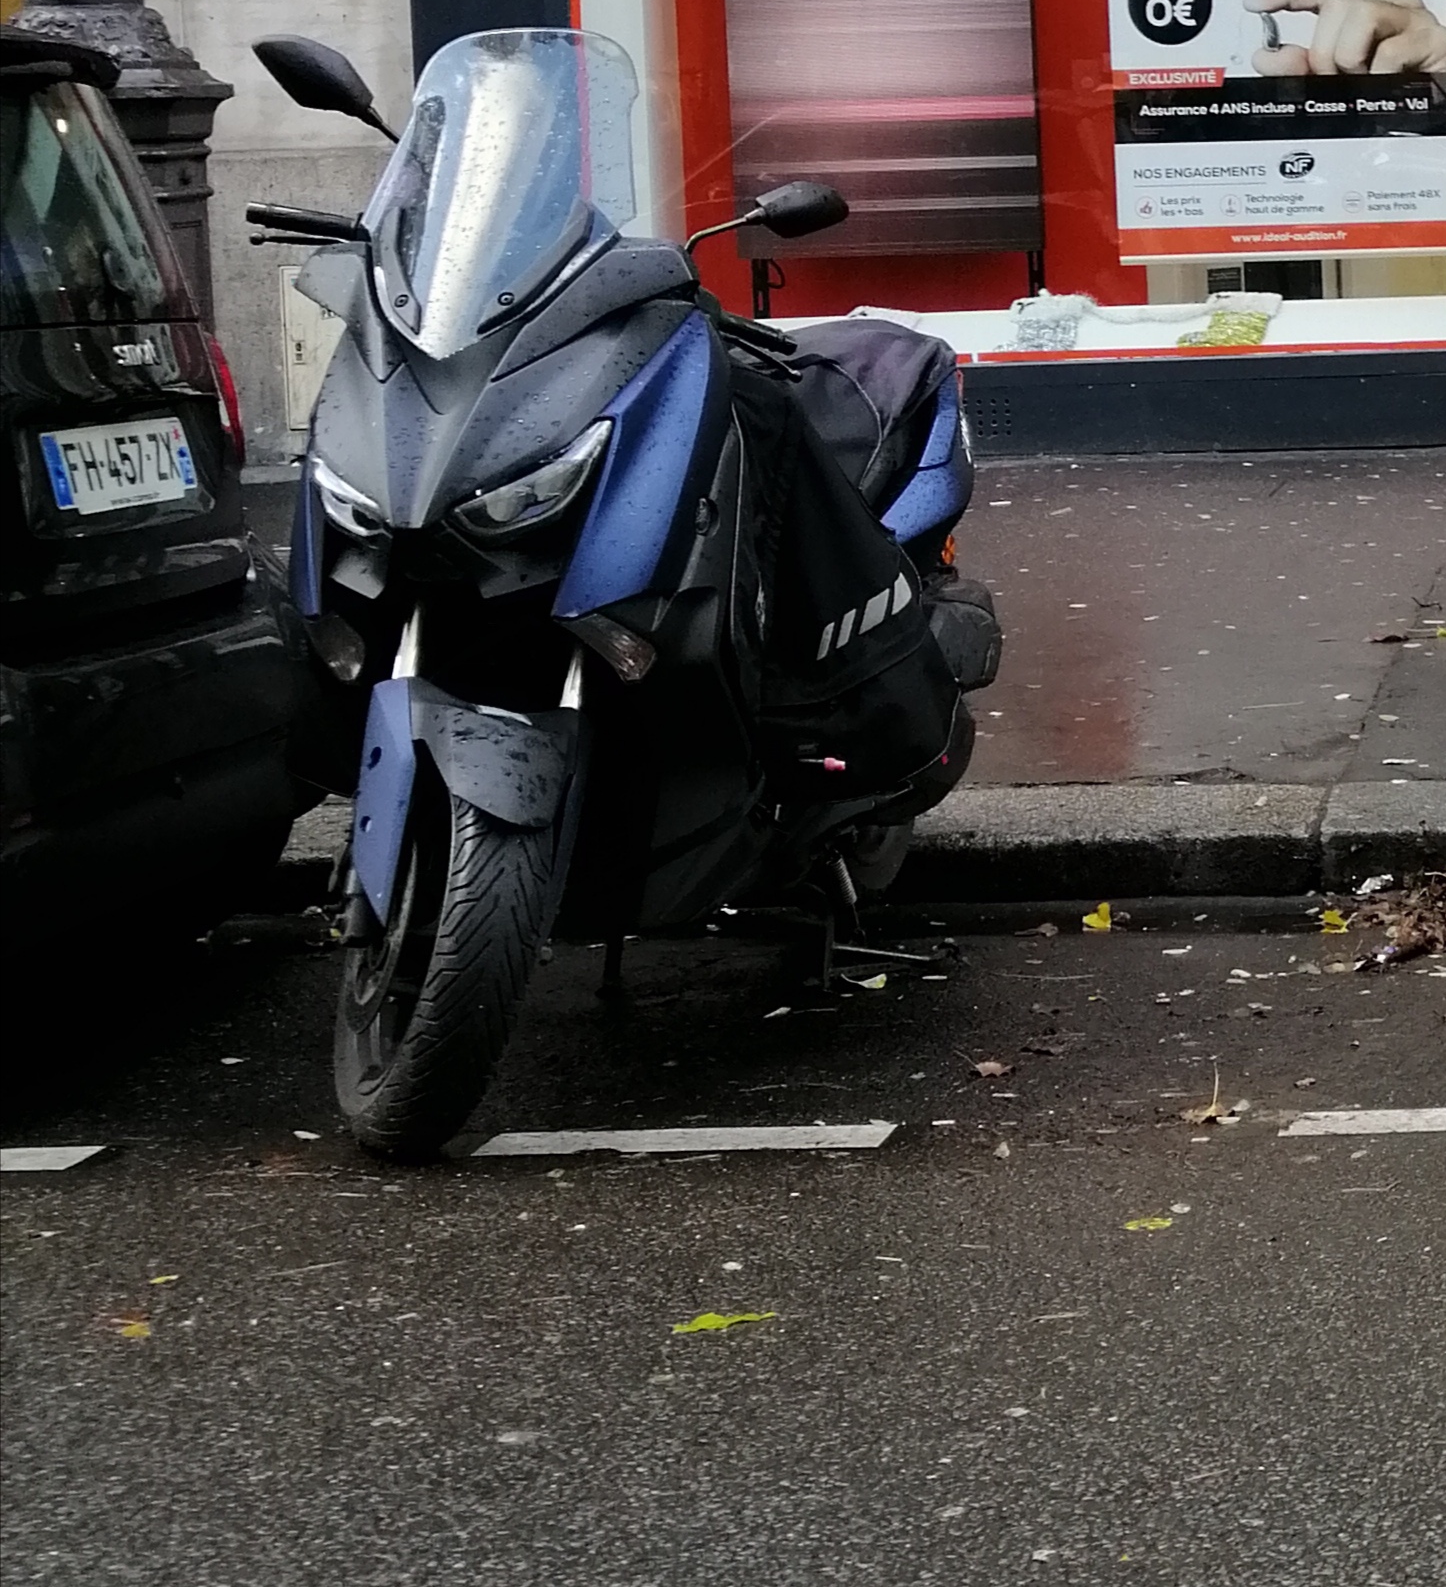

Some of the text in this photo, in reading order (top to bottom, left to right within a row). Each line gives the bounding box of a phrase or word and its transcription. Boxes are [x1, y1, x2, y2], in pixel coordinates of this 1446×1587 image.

[1128, 69, 1217, 85] EXCLUSIVITÉ
[1139, 97, 1429, 117] Assurance 4 ANS incluse Casse Perte Vol
[1284, 158, 1312, 173] NF
[1133, 165, 1267, 180] NOS ENGAGEMENTS
[1160, 195, 1202, 207] Les prix
[1245, 193, 1305, 205] Technologie
[1367, 190, 1416, 200] Paiement
[1160, 206, 1176, 217] les
[1185, 206, 1205, 216] bas
[1245, 204, 1325, 216] haut de gamme
[1367, 201, 1417, 212] sans frais
[1231, 230, 1348, 243] www.ideal-audition.fr
